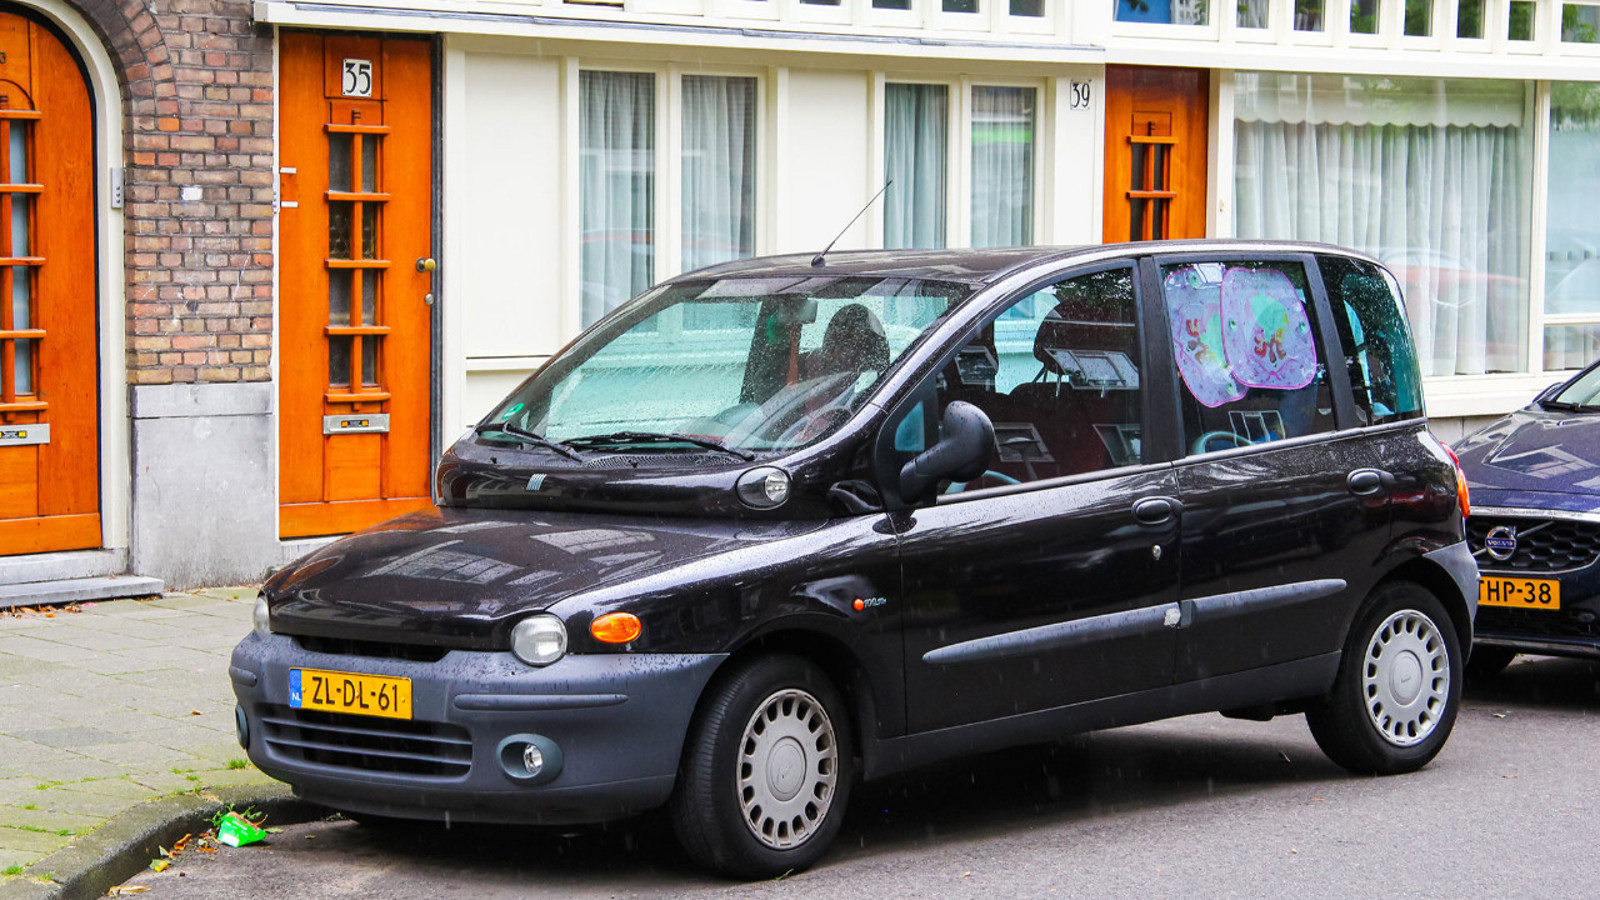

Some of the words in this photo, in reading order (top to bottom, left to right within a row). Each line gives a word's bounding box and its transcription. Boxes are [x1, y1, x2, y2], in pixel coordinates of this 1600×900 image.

[345, 62, 371, 94] 35
[1071, 82, 1090, 108] 39
[292, 692, 302, 702] NL
[312, 676, 398, 712] ZL-DL-61
